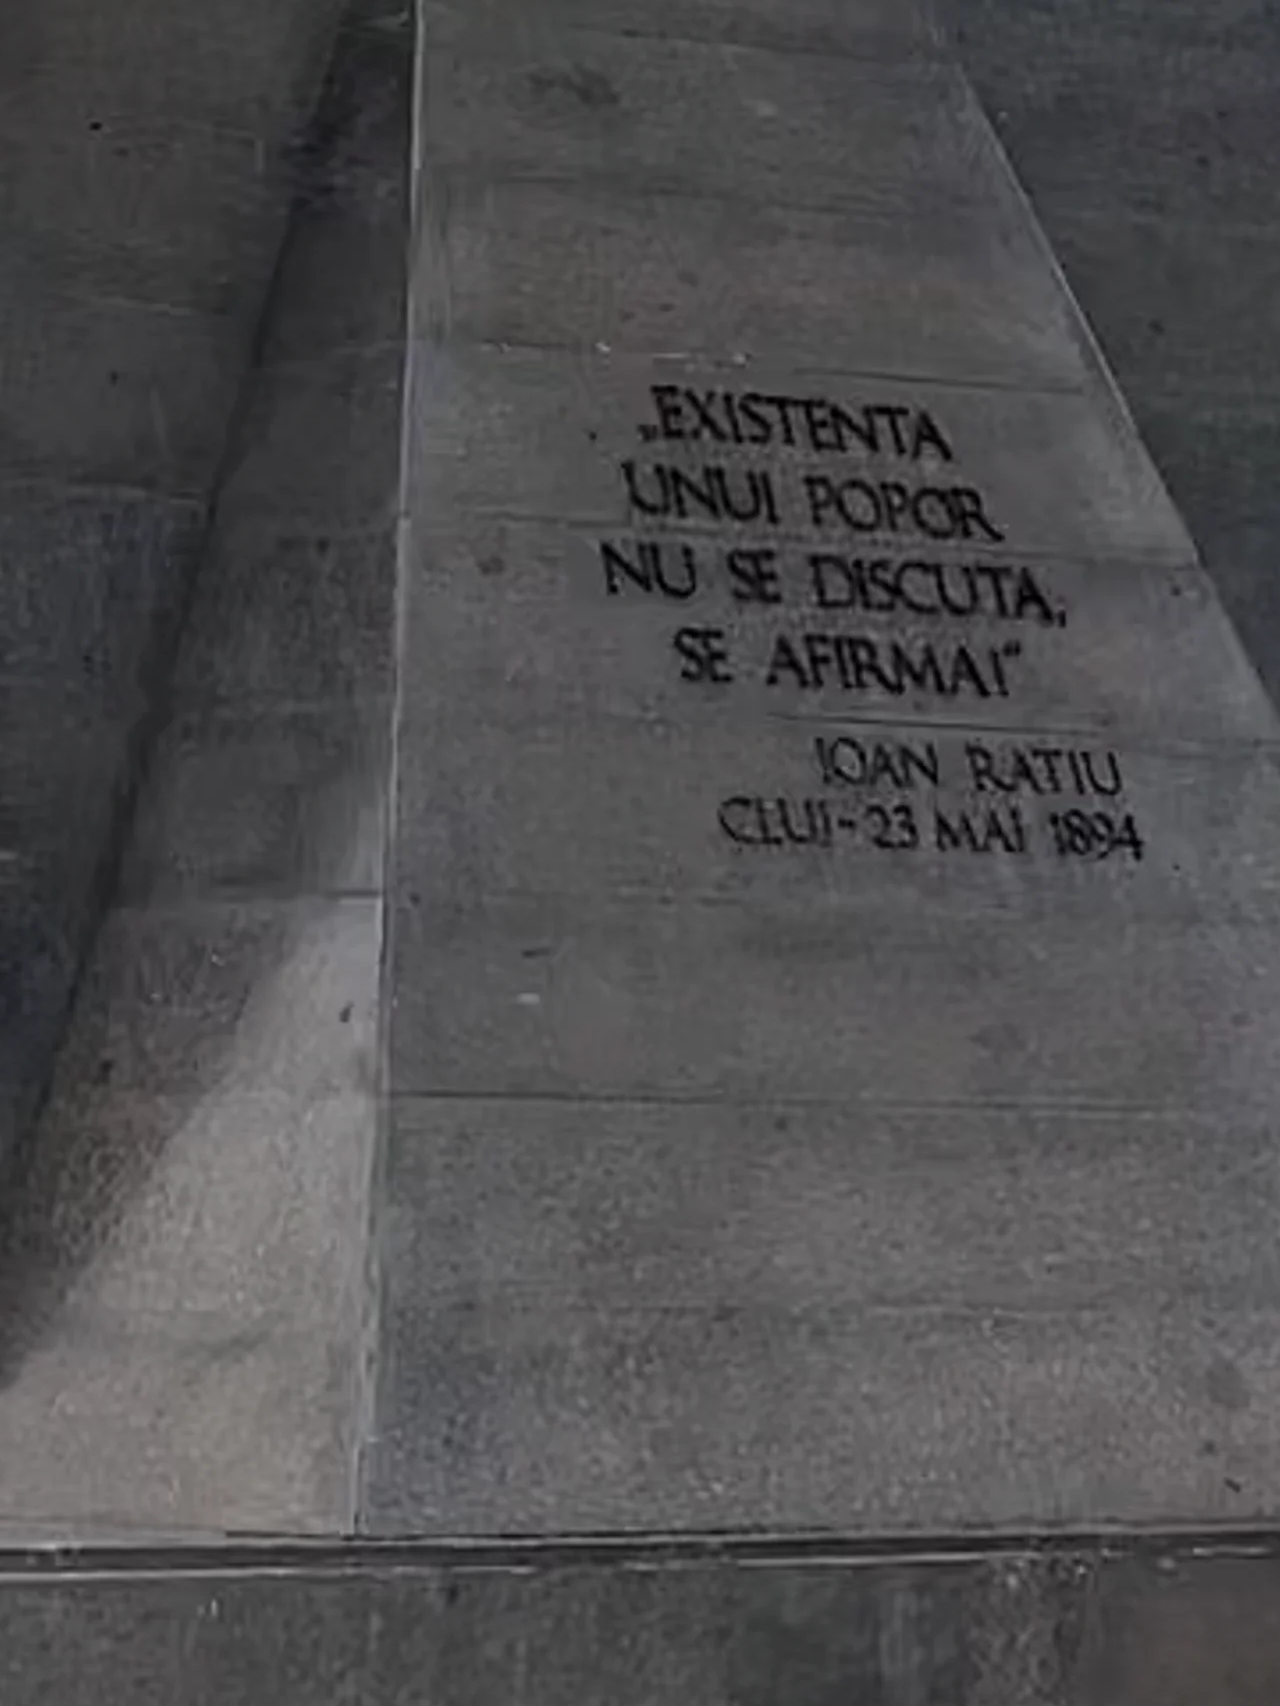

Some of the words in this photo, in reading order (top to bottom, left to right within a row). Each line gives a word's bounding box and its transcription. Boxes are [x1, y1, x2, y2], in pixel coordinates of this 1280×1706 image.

[621, 460, 780, 526] UNUI
[804, 476, 1006, 543] POPOR
[601, 541, 697, 599] NU
[726, 549, 782, 604] SE
[811, 554, 1067, 627] DISCUTA,
[674, 627, 733, 683] SE
[815, 737, 938, 788] IOAN
[934, 805, 1024, 853] MAI
[1050, 808, 1144, 862] 1894
